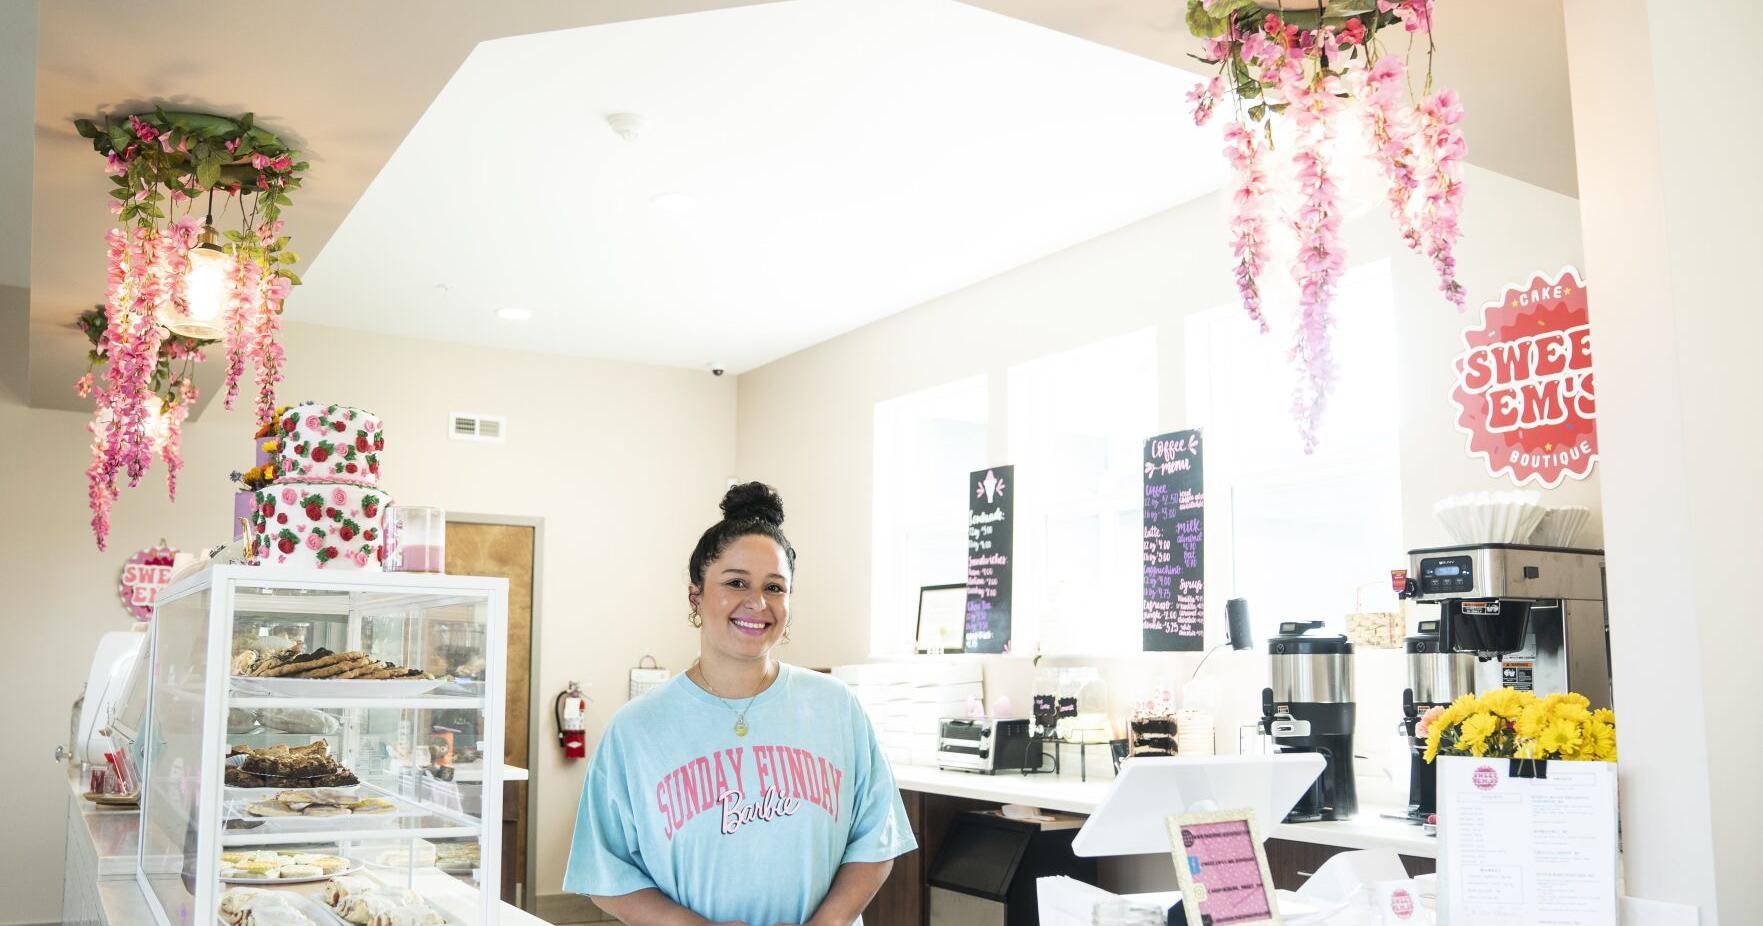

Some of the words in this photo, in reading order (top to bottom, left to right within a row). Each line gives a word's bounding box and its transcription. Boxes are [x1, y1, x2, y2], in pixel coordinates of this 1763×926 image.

[1519, 285, 1563, 307] CAKE
[1152, 440, 1187, 462] Coffee
[1509, 441, 1592, 468] BOUTIQUE
[1159, 458, 1191, 476] menu
[656, 746, 746, 841] SUNDAY
[752, 745, 843, 824] FUNDAY
[716, 784, 801, 835] Barbie
